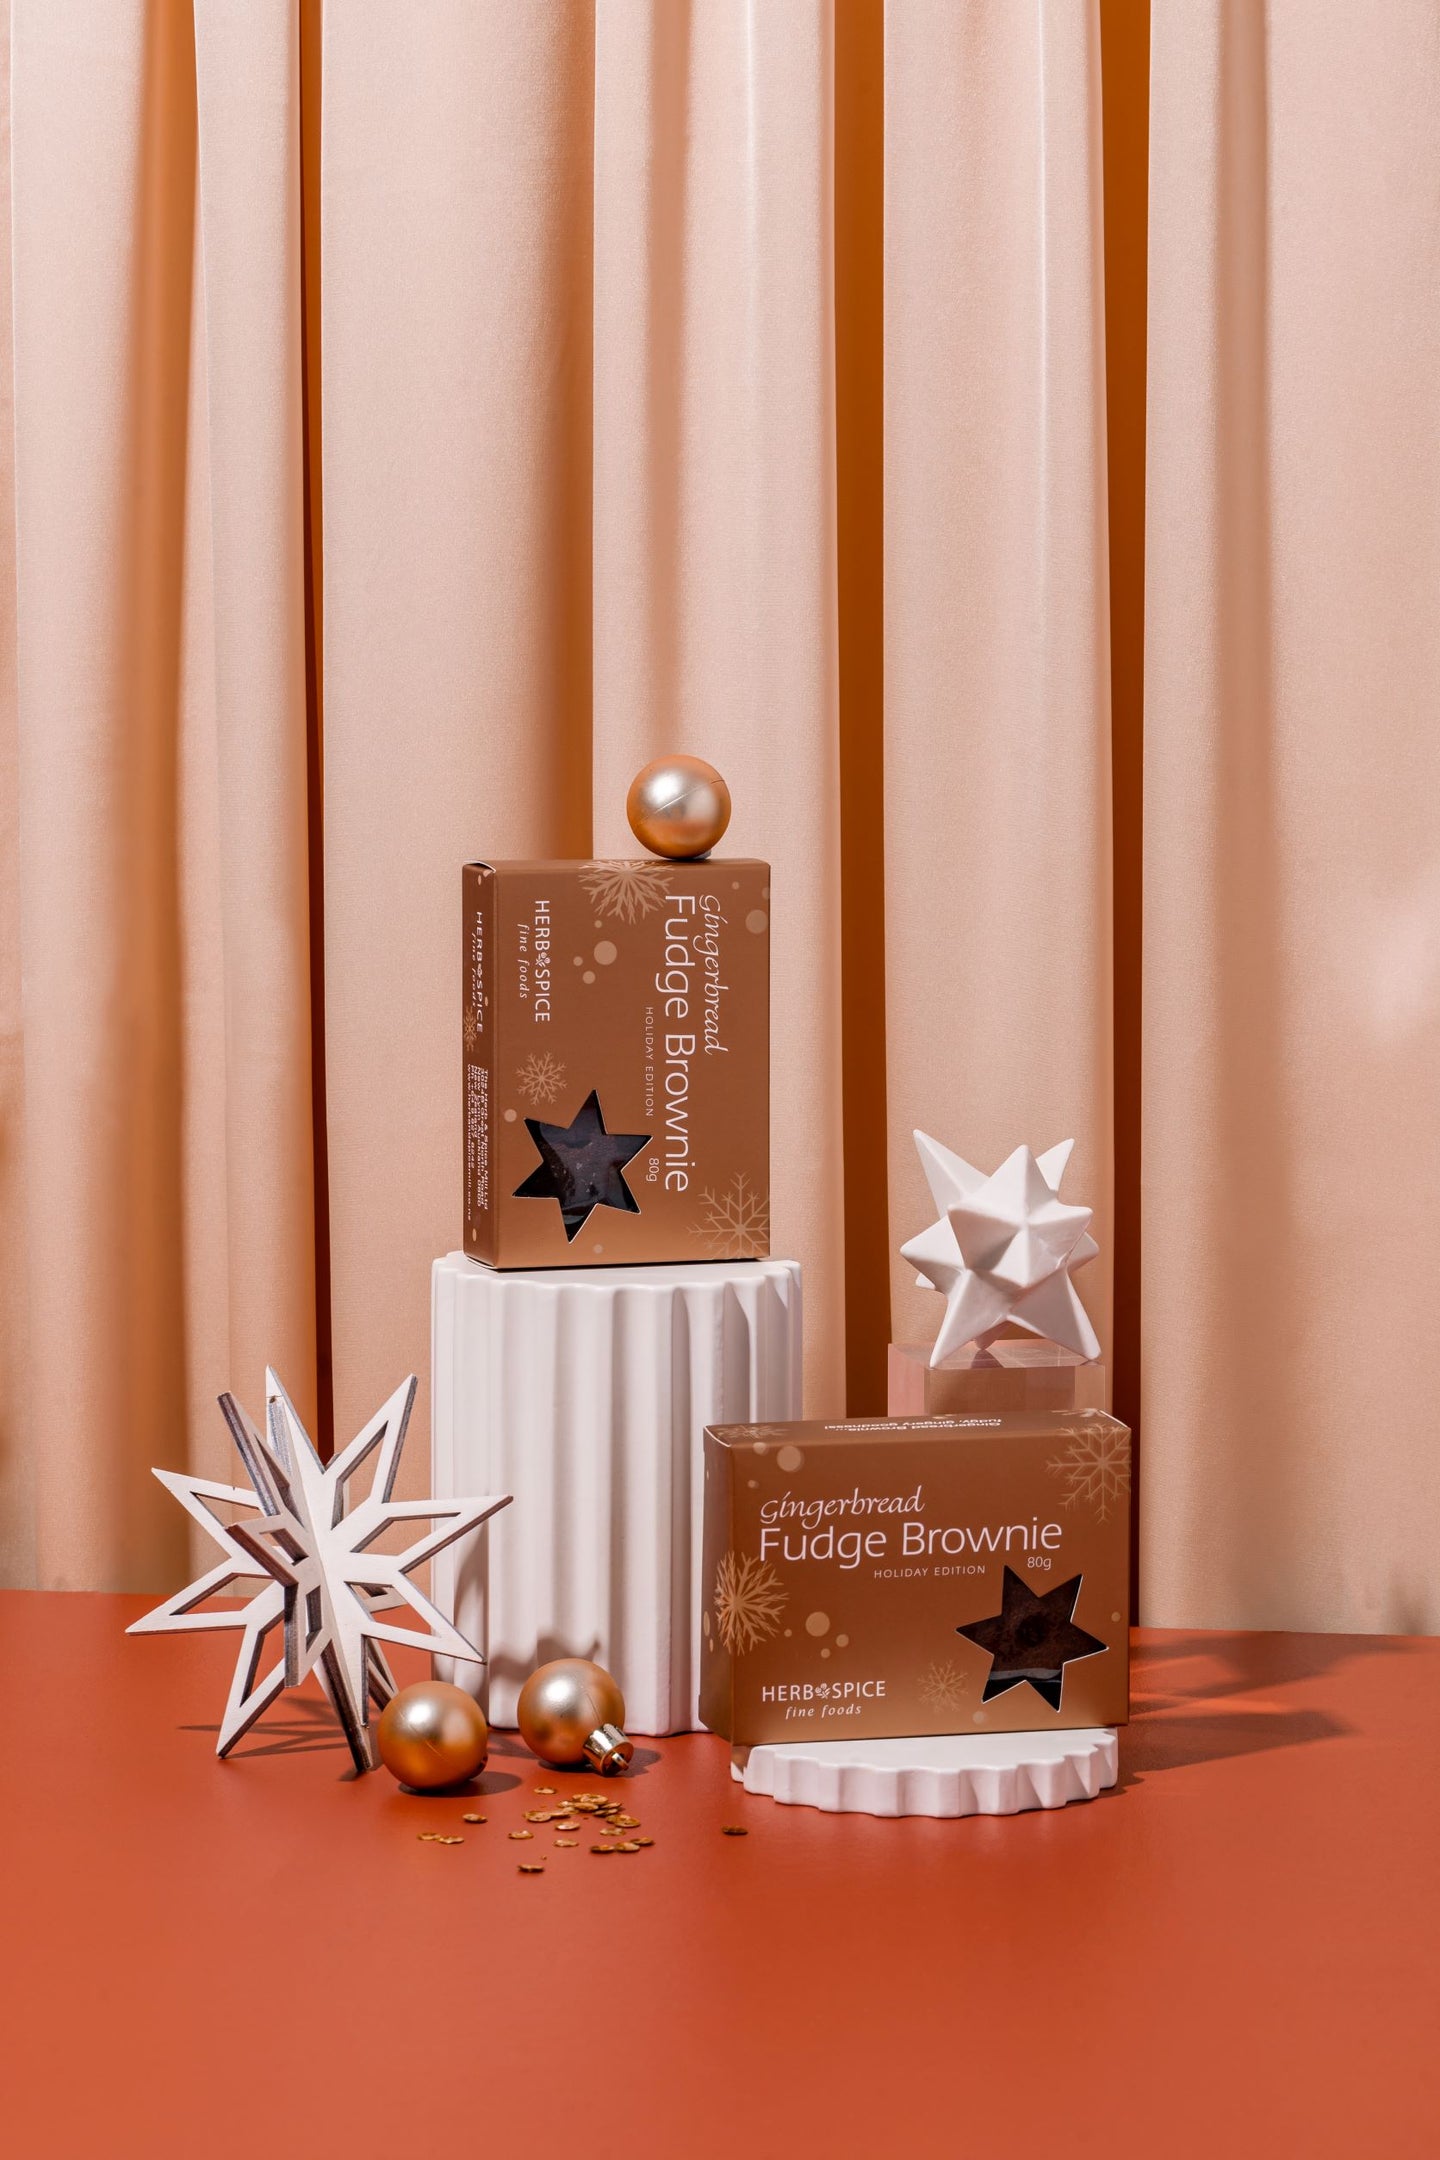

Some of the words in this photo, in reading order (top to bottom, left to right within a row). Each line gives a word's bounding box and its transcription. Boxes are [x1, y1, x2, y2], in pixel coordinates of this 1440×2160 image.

[517, 923, 530, 952] fine
[534, 900, 551, 951] HERB
[517, 959, 530, 999] foods
[655, 895, 696, 1019] Fudge
[692, 894, 729, 1056] Gingerbread
[534, 969, 551, 1022] SPICE
[645, 1006, 654, 1060] HOLIDAY
[645, 1066, 654, 1117] EDITION
[664, 1034, 696, 1192] Brownie
[645, 1157, 660, 1182] 80g
[760, 1485, 926, 1530] Gingerbread
[760, 1525, 887, 1570] Fudge
[902, 1516, 1063, 1556] Brownie
[1026, 1556, 1052, 1571] 80g
[873, 1567, 929, 1579] HOLIDAY
[934, 1565, 986, 1577] EDITION
[762, 1683, 814, 1702] HERB
[832, 1680, 886, 1699] SPICE
[785, 1706, 815, 1720] fine
[821, 1703, 862, 1719] foods
